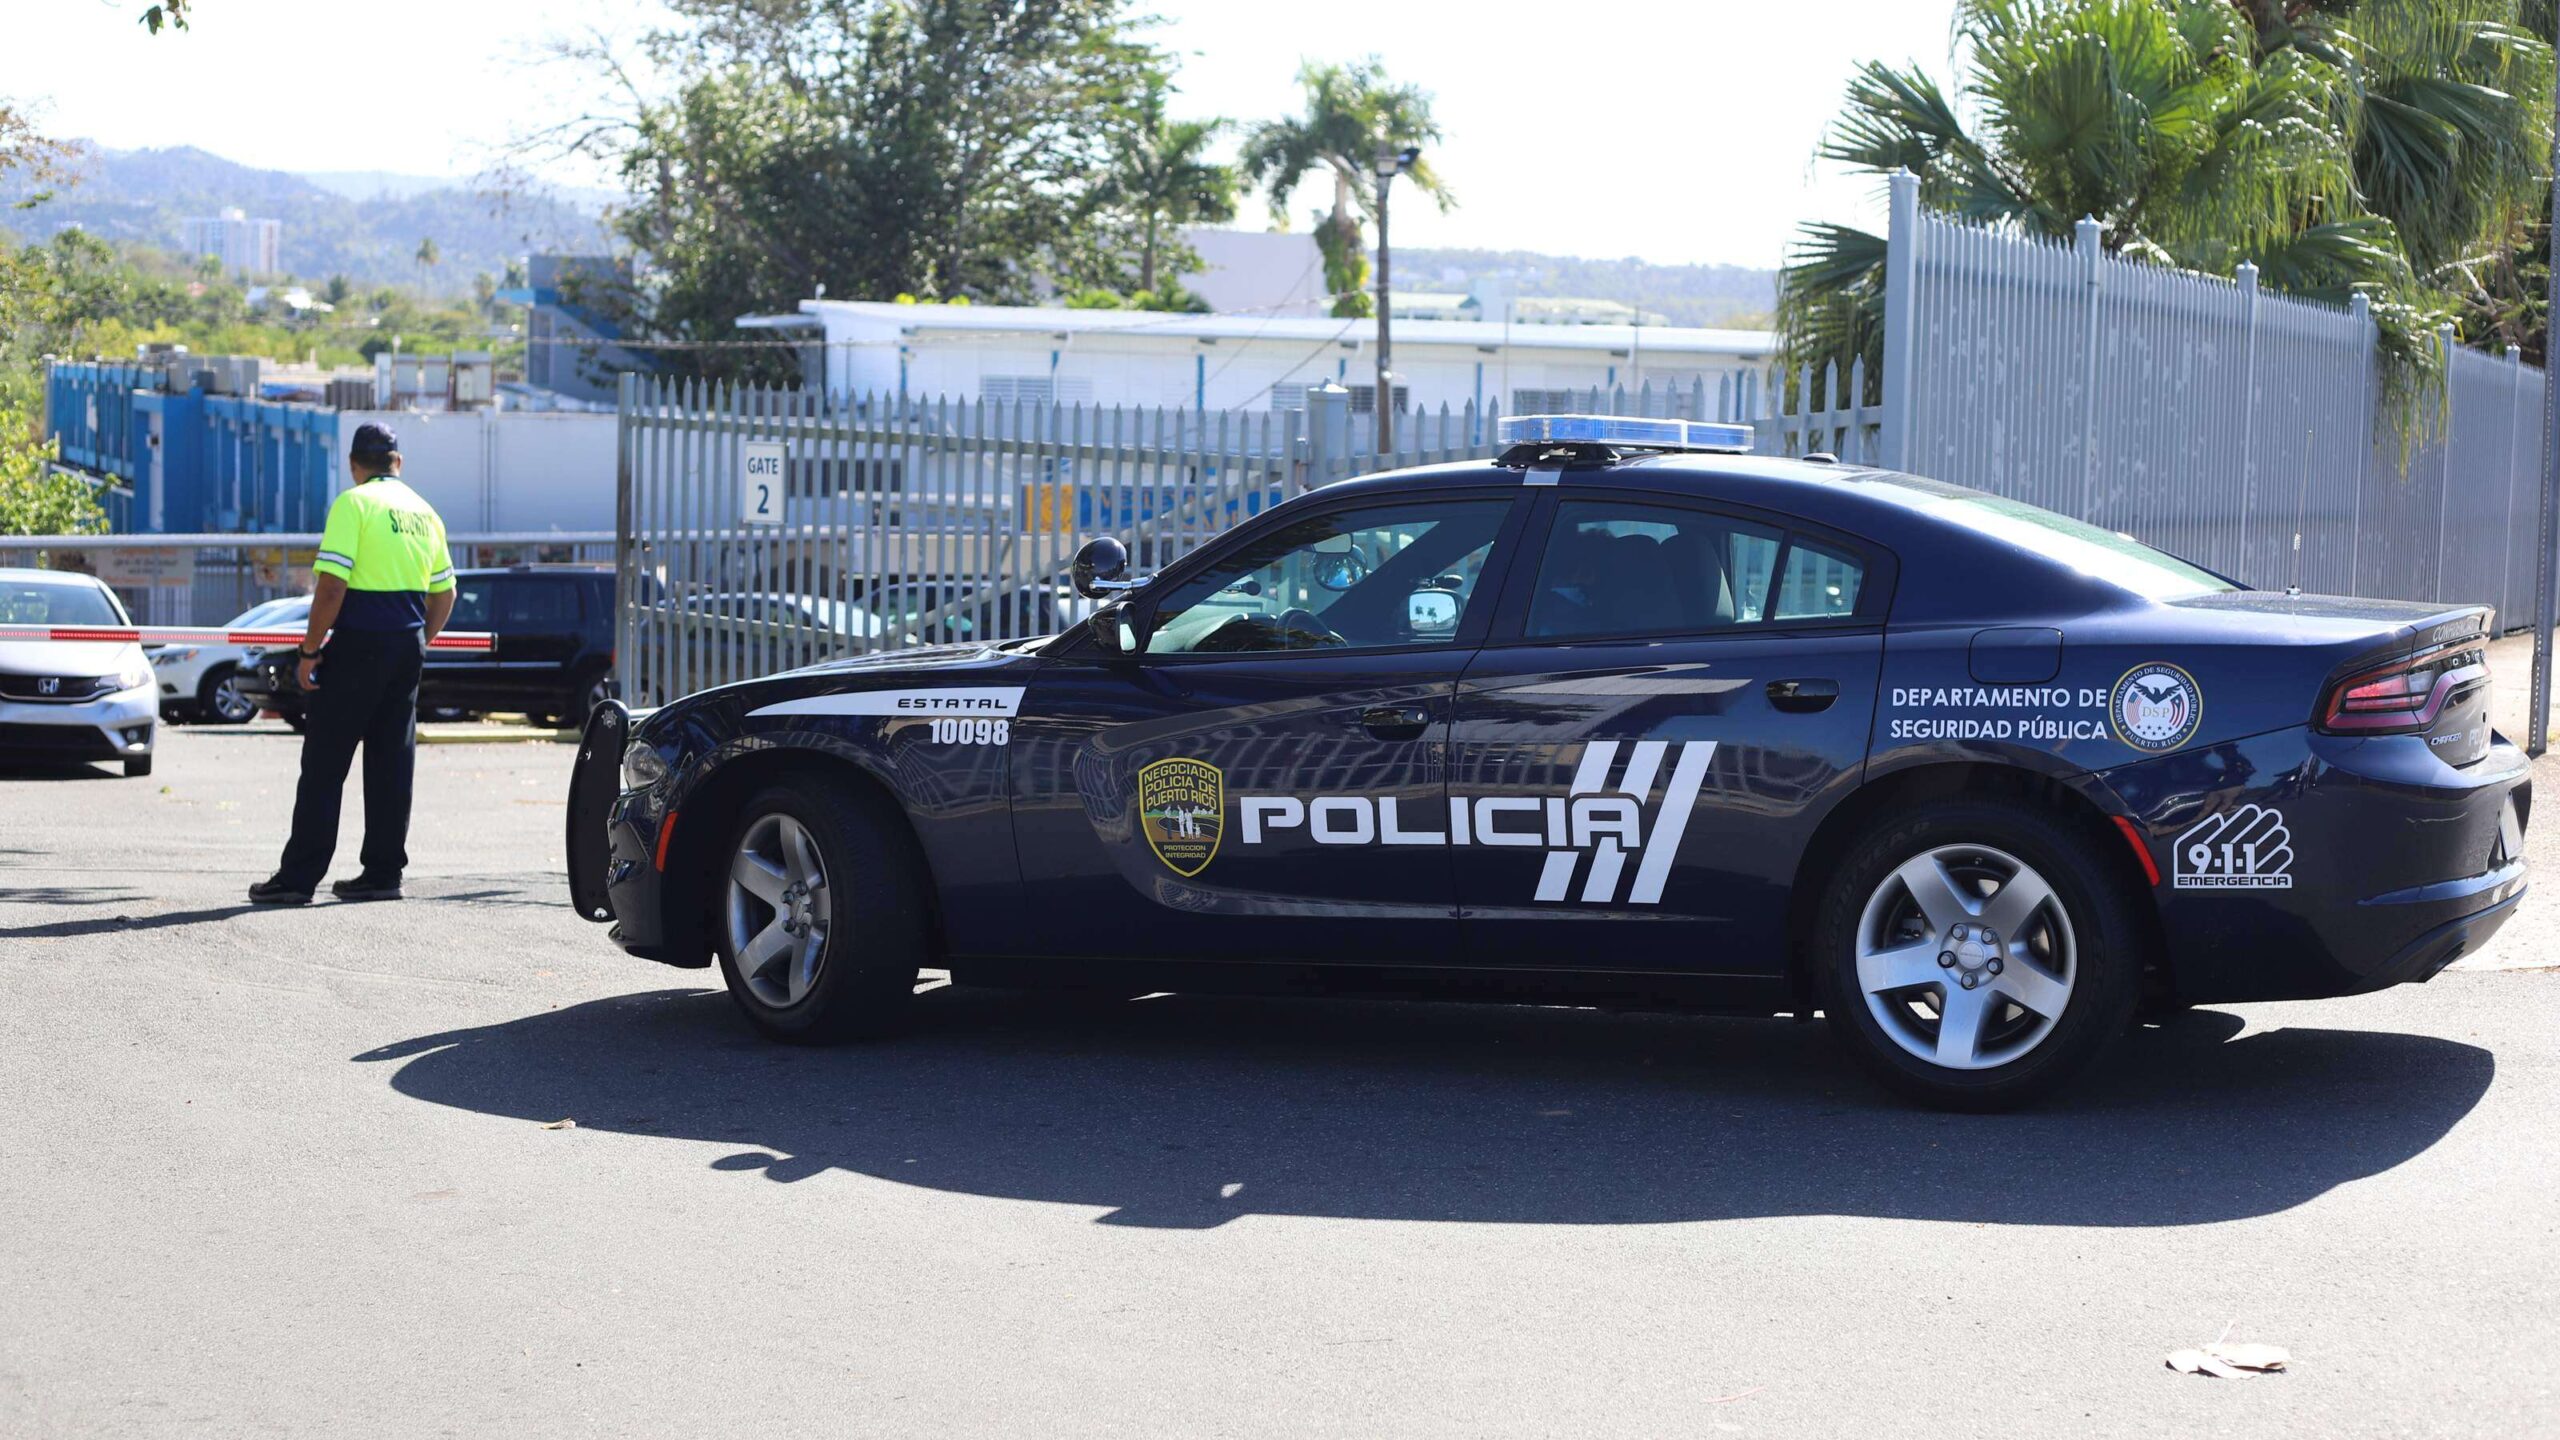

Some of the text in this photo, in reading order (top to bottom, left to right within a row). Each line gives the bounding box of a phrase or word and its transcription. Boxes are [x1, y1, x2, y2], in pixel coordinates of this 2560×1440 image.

[748, 457, 778, 474] GATE
[757, 484, 769, 513] 2
[388, 508, 433, 537] SECURIT
[897, 698, 1008, 709] ESTATAL
[1892, 688, 2107, 707] DEPARTAMENTO DE
[2115, 671, 2143, 724] DEPARTAMENTO
[2144, 666, 2155, 674] DE
[2156, 666, 2194, 693] SEGURIDAD
[929, 718, 1009, 746] 10098
[1890, 715, 2108, 739] SEGURIDAD PÚBLICA
[2125, 730, 2182, 748] PUERTO RICO
[1144, 763, 1217, 785] NEGOCIADO
[1145, 775, 1217, 798] POLICIA DE
[1146, 788, 1217, 811] PUERTO RICO
[1240, 796, 1641, 848] POLICIA
[2177, 876, 2289, 886] EMERGENCIA
